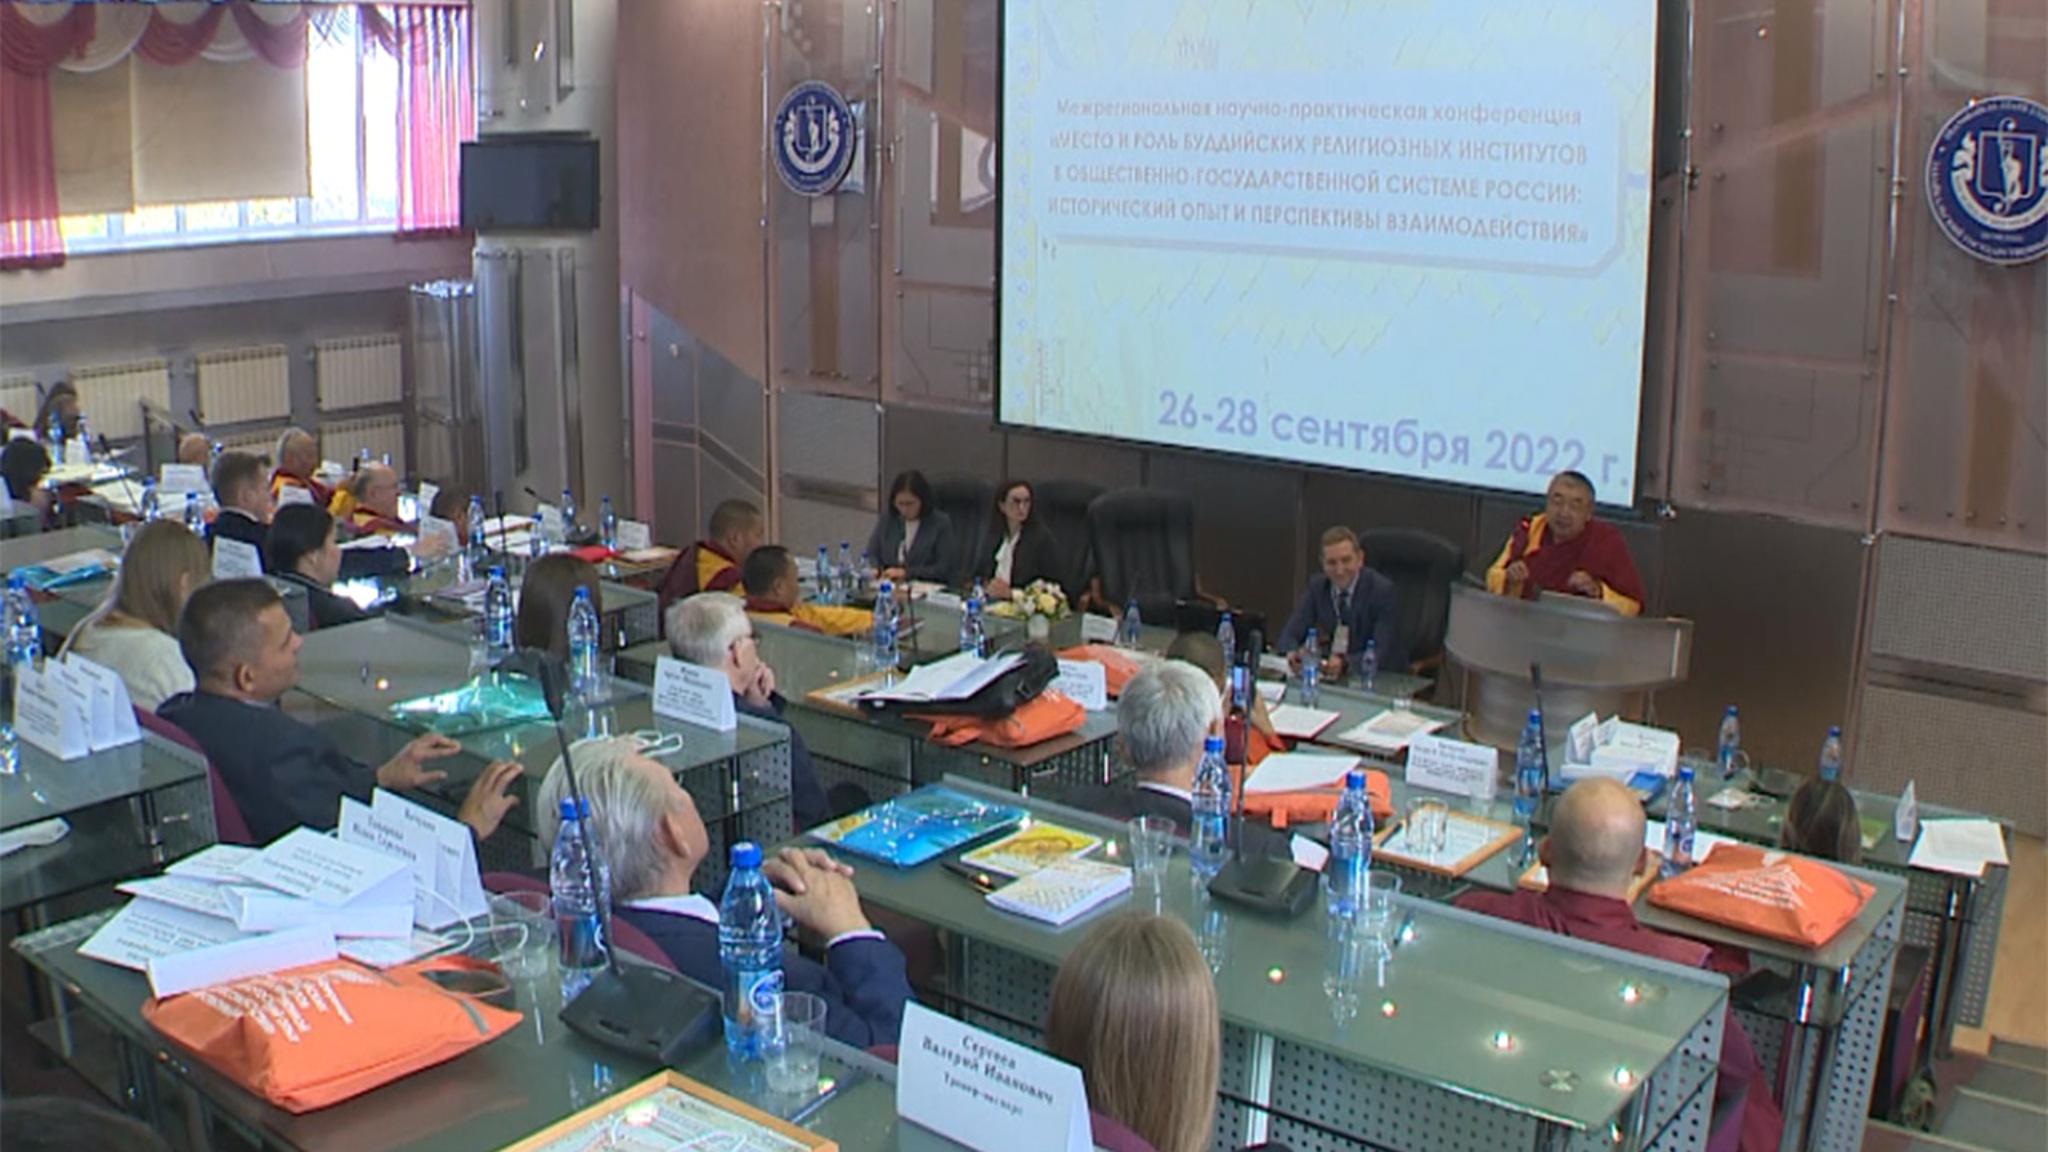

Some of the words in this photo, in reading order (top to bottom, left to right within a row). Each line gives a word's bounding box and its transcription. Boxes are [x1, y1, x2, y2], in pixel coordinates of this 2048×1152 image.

[1055, 100, 1210, 119] Межрегиональная
[1216, 101, 1427, 121] научно-практическая
[1432, 103, 1582, 126] конференция
[1119, 131, 1129, 149] И
[1134, 132, 1178, 150] РОЛЬ
[1183, 131, 1305, 154] БУДДИЙСКИХ
[1312, 136, 1452, 159] РЕЛИГИОЗНЫХ
[1458, 140, 1588, 165] ИНСТИТУТОВ
[1053, 164, 1061, 182] В
[1066, 165, 1380, 194] ОБЩЕСТВЕННО-ГОСУДАРСТВЕННОЙ
[1386, 174, 1479, 198] СИСТЕМЕ
[1485, 179, 1583, 204] РОССИИ:
[1048, 197, 1176, 219] ИСТОРИЧЕСКИЙ
[1181, 202, 1229, 222] ОПЫТ
[1234, 204, 1246, 222] И
[1251, 205, 1380, 231] ПЕРСПЕКТИВЫ
[1386, 212, 1589, 243] ВЗАИМОДЕЙСТВИЯ»
[1158, 390, 1259, 437] 26-28
[1271, 411, 1470, 469] сентября
[1484, 429, 1587, 475] 2022
[1601, 452, 1628, 488] г.
[922, 1035, 979, 1073] Валерий
[984, 1061, 1054, 1105] Иванович
